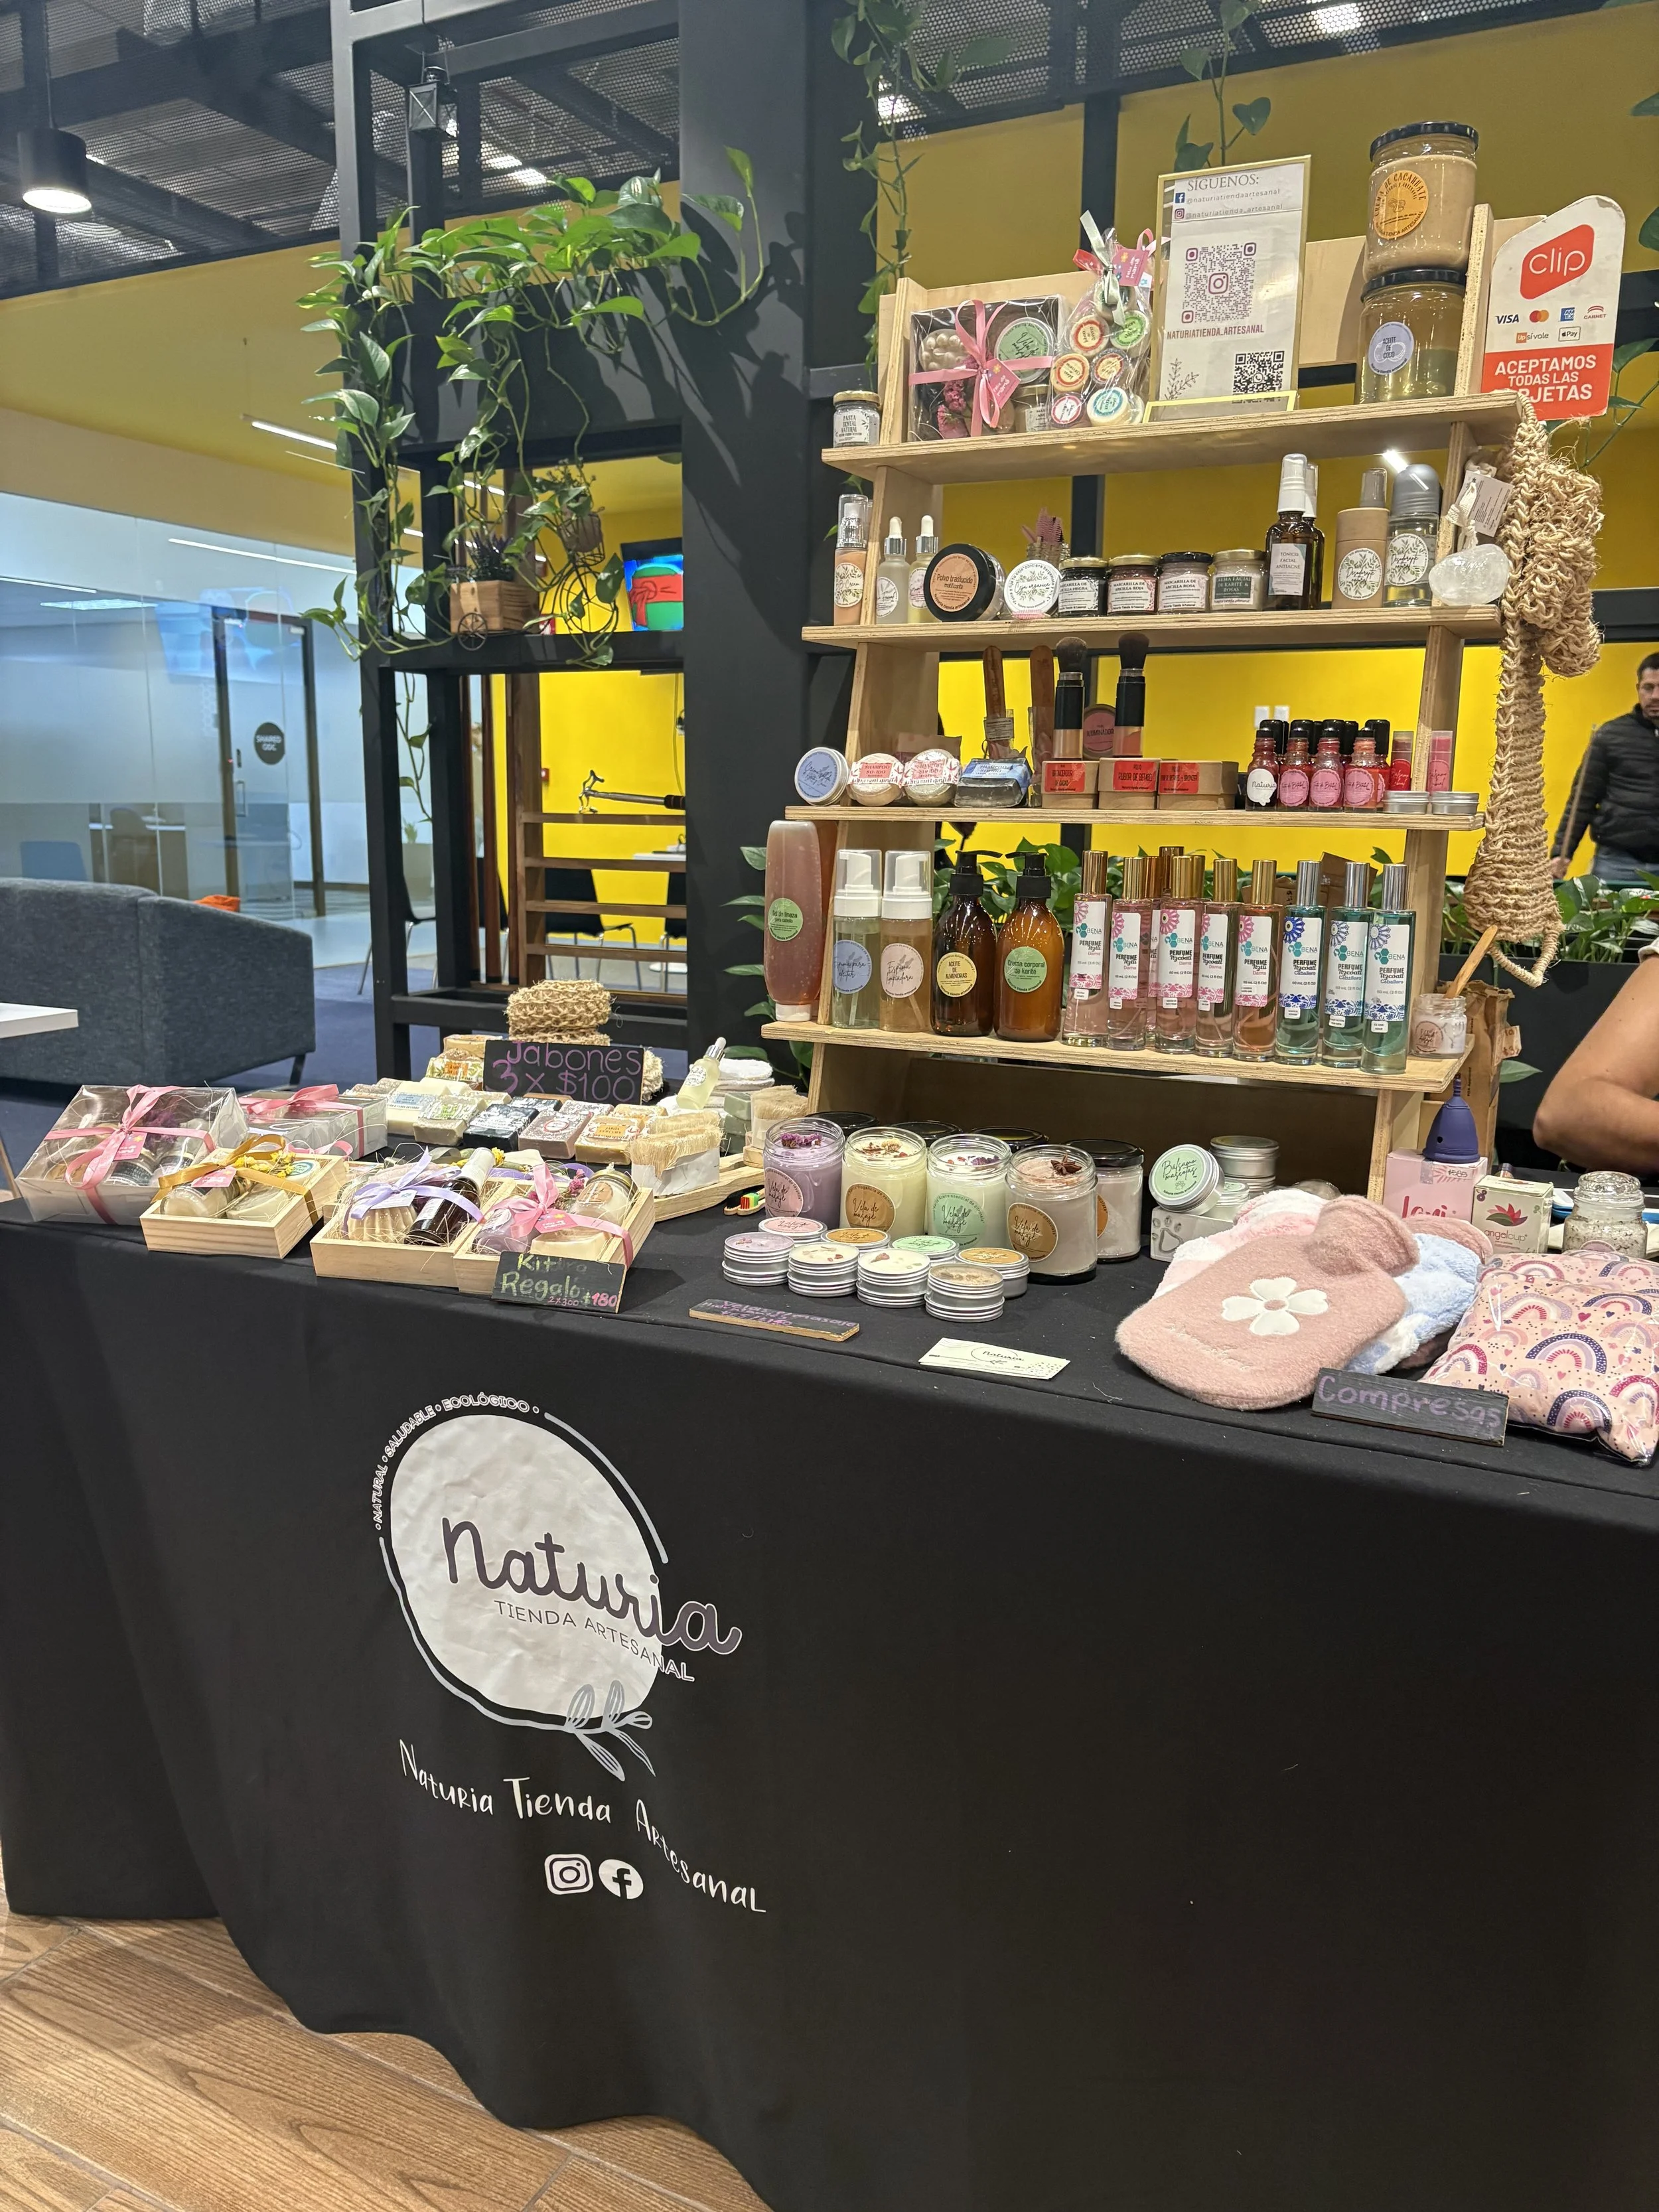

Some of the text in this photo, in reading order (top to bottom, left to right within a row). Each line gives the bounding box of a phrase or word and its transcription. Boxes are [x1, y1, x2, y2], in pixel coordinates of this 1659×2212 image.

[1187, 173, 1260, 192] SÍGUENOS:
[1394, 172, 1426, 200] CACAHUATE
[1529, 247, 1585, 277] clip
[1494, 314, 1520, 325] VISA
[1167, 324, 1264, 340] NATURIATIENDA_ARTESANAL
[1494, 354, 1597, 376] ACEPTAMOS
[1508, 372, 1579, 388] TODAS LAS
[1518, 384, 1593, 404] RJETAS
[936, 573, 974, 584] Polvo traslucido
[506, 1041, 643, 1075] Jabones
[485, 1059, 518, 1094] 3
[555, 1070, 635, 1102] $100
[853, 1197, 879, 1215] Vela de
[942, 1205, 960, 1221] Vela
[1014, 1215, 1030, 1232] Vela
[1484, 1229, 1526, 1242] angelcup
[517, 1253, 557, 1273] Kit
[500, 1271, 581, 1301] Regalo
[1318, 1375, 1502, 1428] Compresas
[371, 1391, 531, 1524] NATURAL SALUDABLE ECOLÓGICO
[493, 1599, 695, 1682] TIENDA ARTESANAL
[503, 1776, 612, 1824] Tienda
